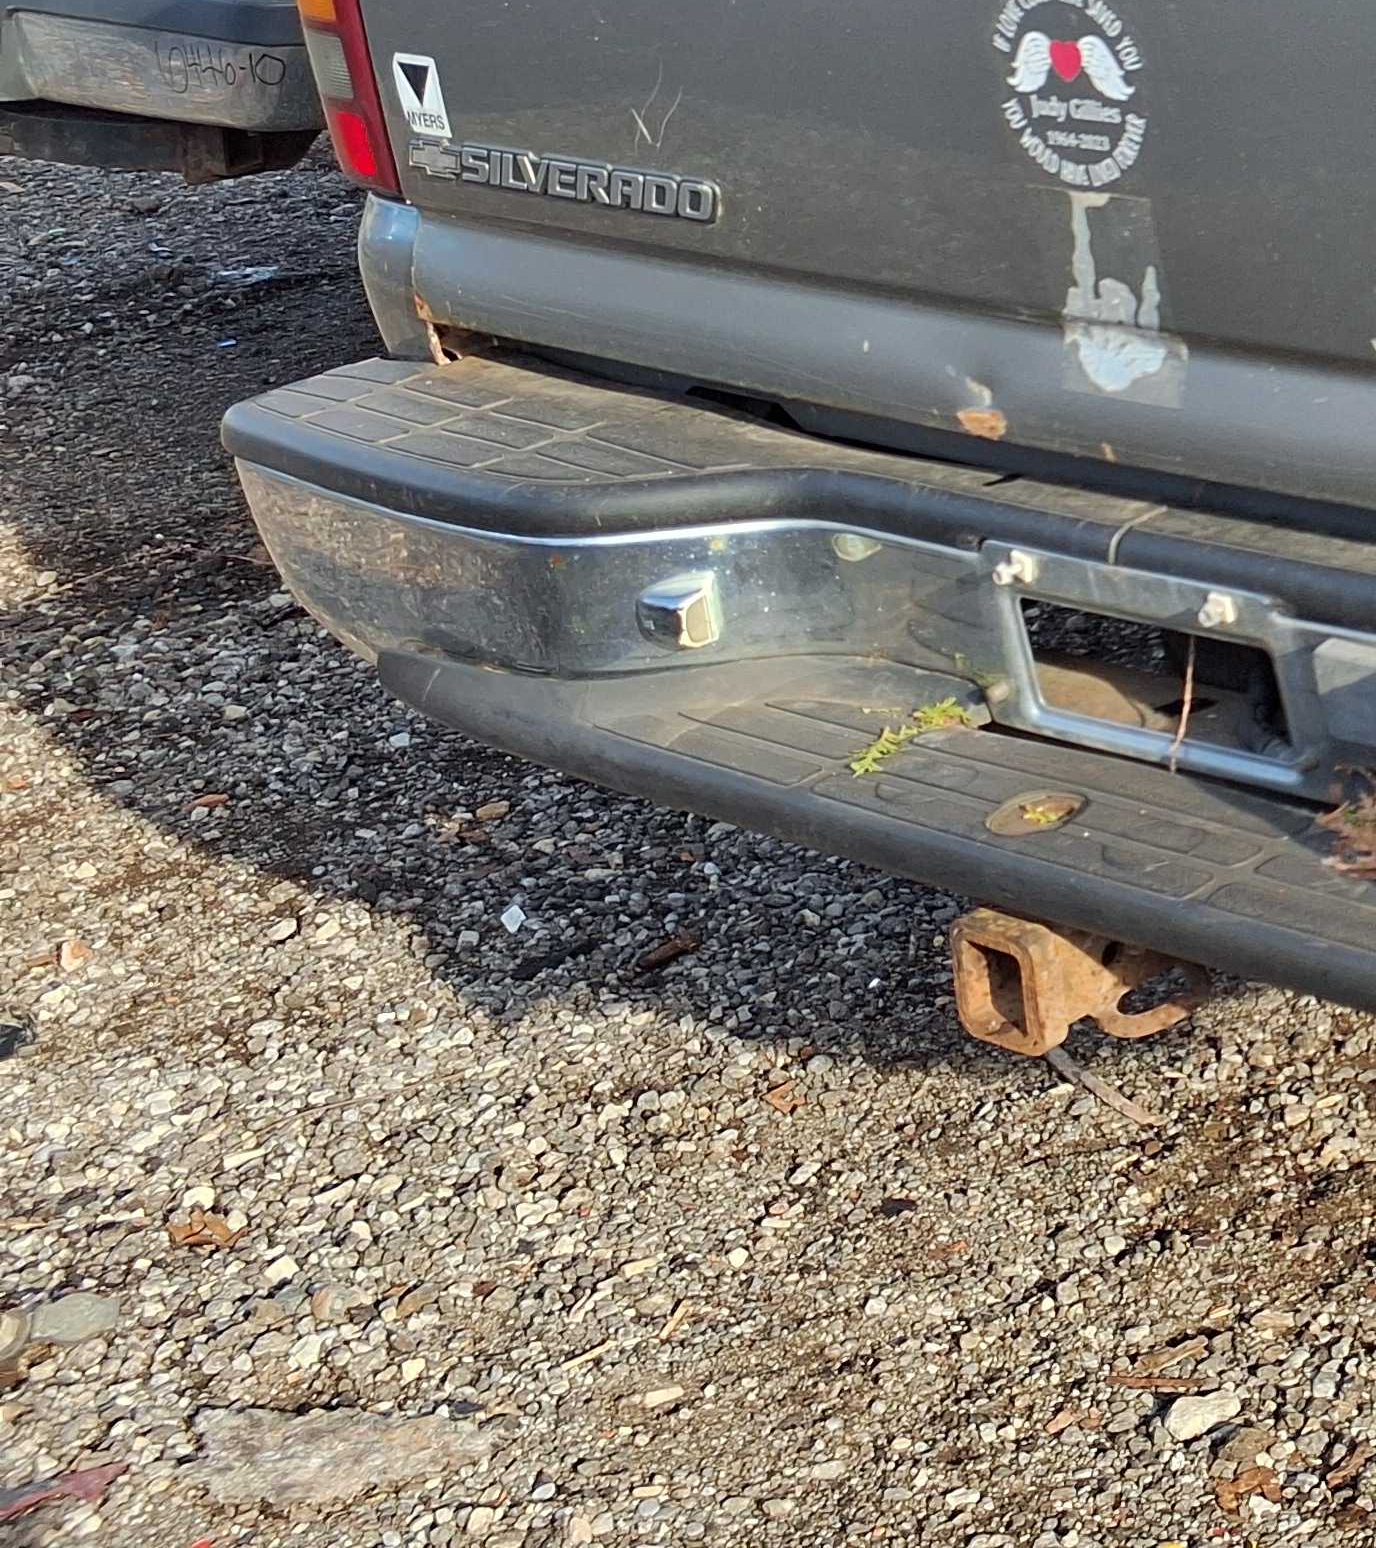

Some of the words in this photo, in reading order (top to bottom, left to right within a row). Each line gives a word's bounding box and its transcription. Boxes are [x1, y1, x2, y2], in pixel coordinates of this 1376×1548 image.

[1115, 35, 1144, 72] YOU
[406, 110, 446, 131] MYERS
[1001, 97, 1029, 130] YOU
[460, 144, 717, 223] SILVERADO
